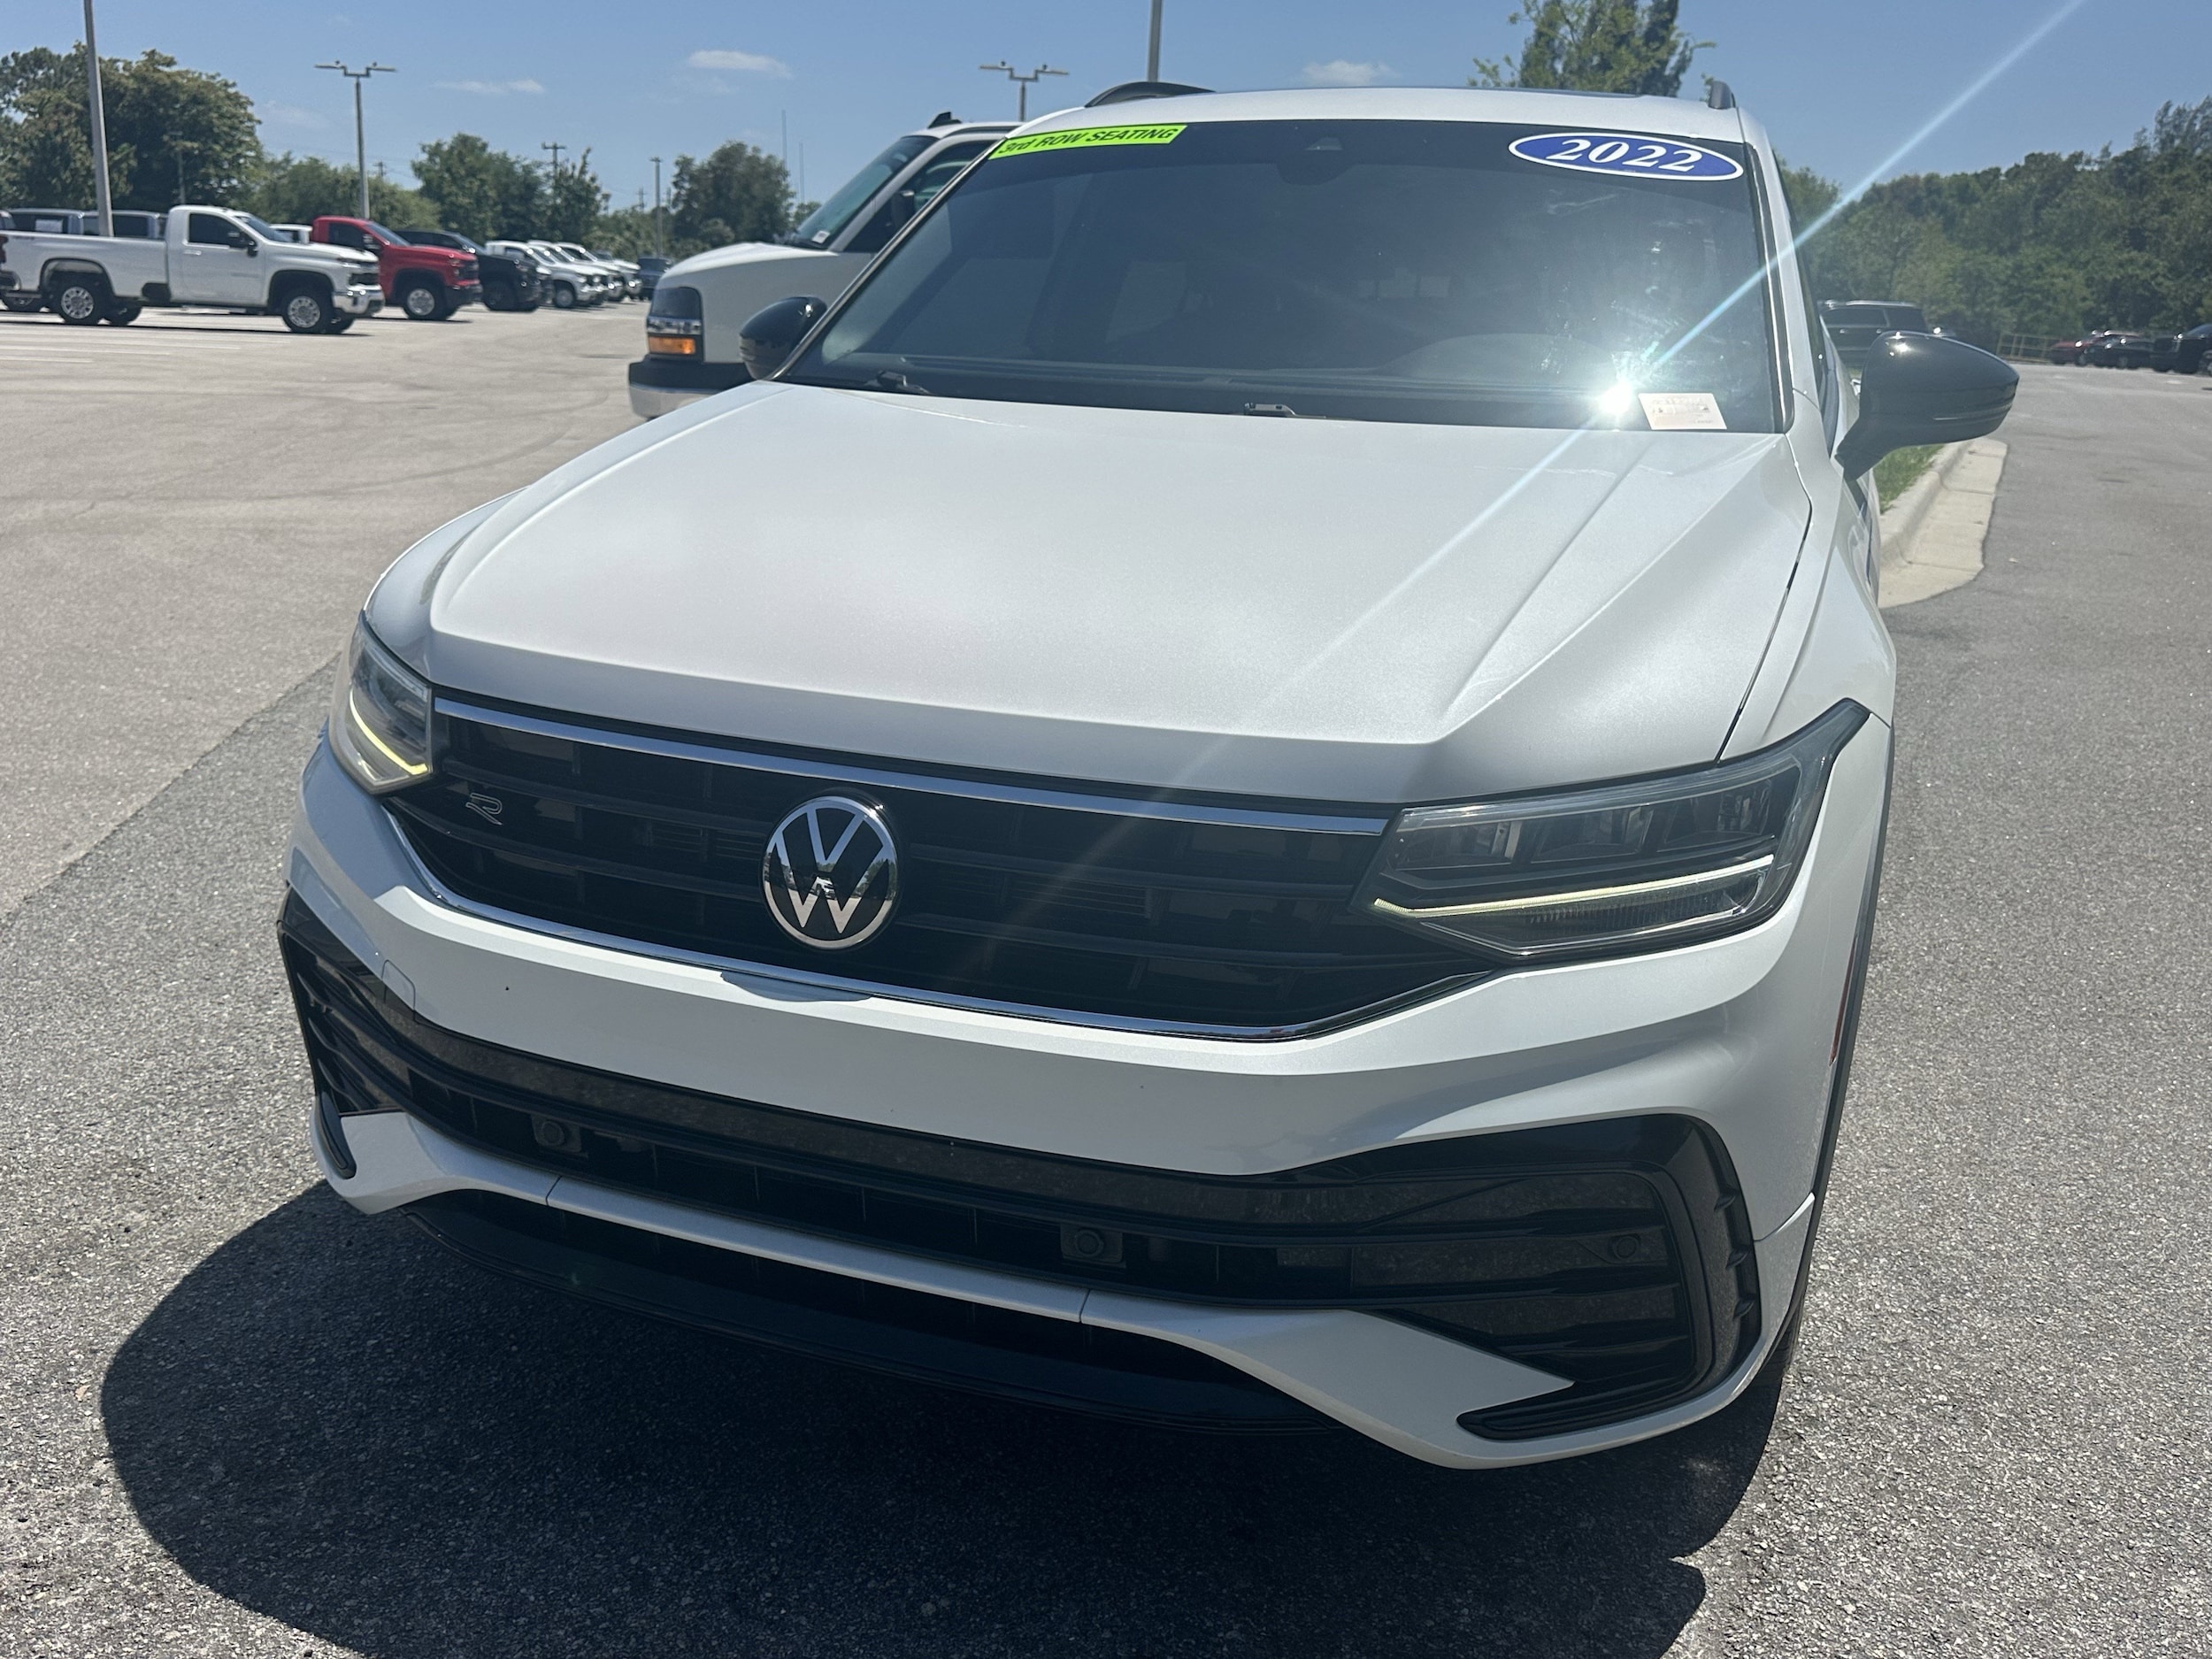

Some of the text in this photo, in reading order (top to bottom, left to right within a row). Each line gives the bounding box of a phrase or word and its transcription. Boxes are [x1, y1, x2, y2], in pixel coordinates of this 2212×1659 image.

[998, 127, 1179, 154] 3rd ROW SEATING
[1546, 139, 1702, 173] 2022
